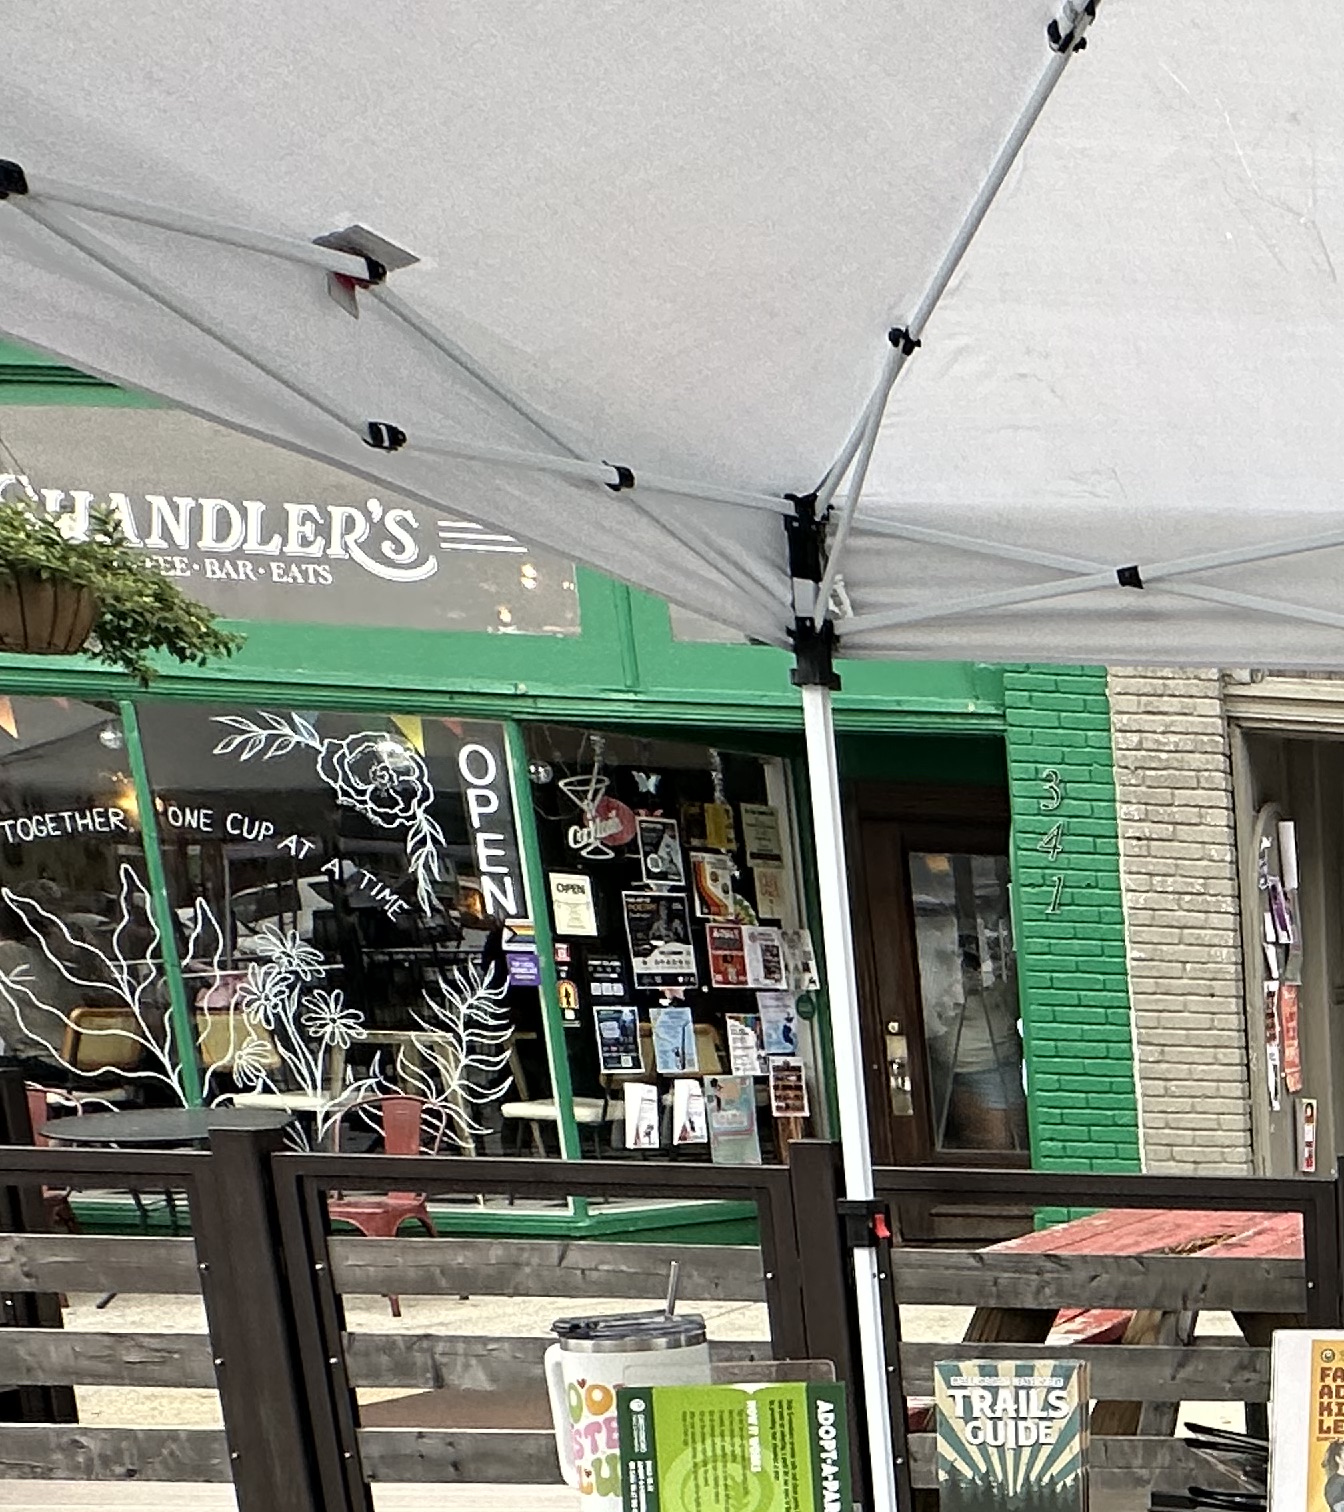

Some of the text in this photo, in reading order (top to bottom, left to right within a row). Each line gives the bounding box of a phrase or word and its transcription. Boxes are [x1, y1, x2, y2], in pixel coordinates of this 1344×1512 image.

[205, 558, 255, 581] BAR
[270, 562, 333, 585] EATS
[458, 743, 518, 915] OPEN
[168, 807, 213, 830] ONE
[226, 812, 274, 842] CUP
[278, 834, 316, 860] AT
[321, 858, 344, 881] A
[358, 869, 409, 922] TIME
[556, 883, 586, 895] OPEN
[947, 1387, 1070, 1419] TRAILS
[965, 1420, 1056, 1449] GUIDE
